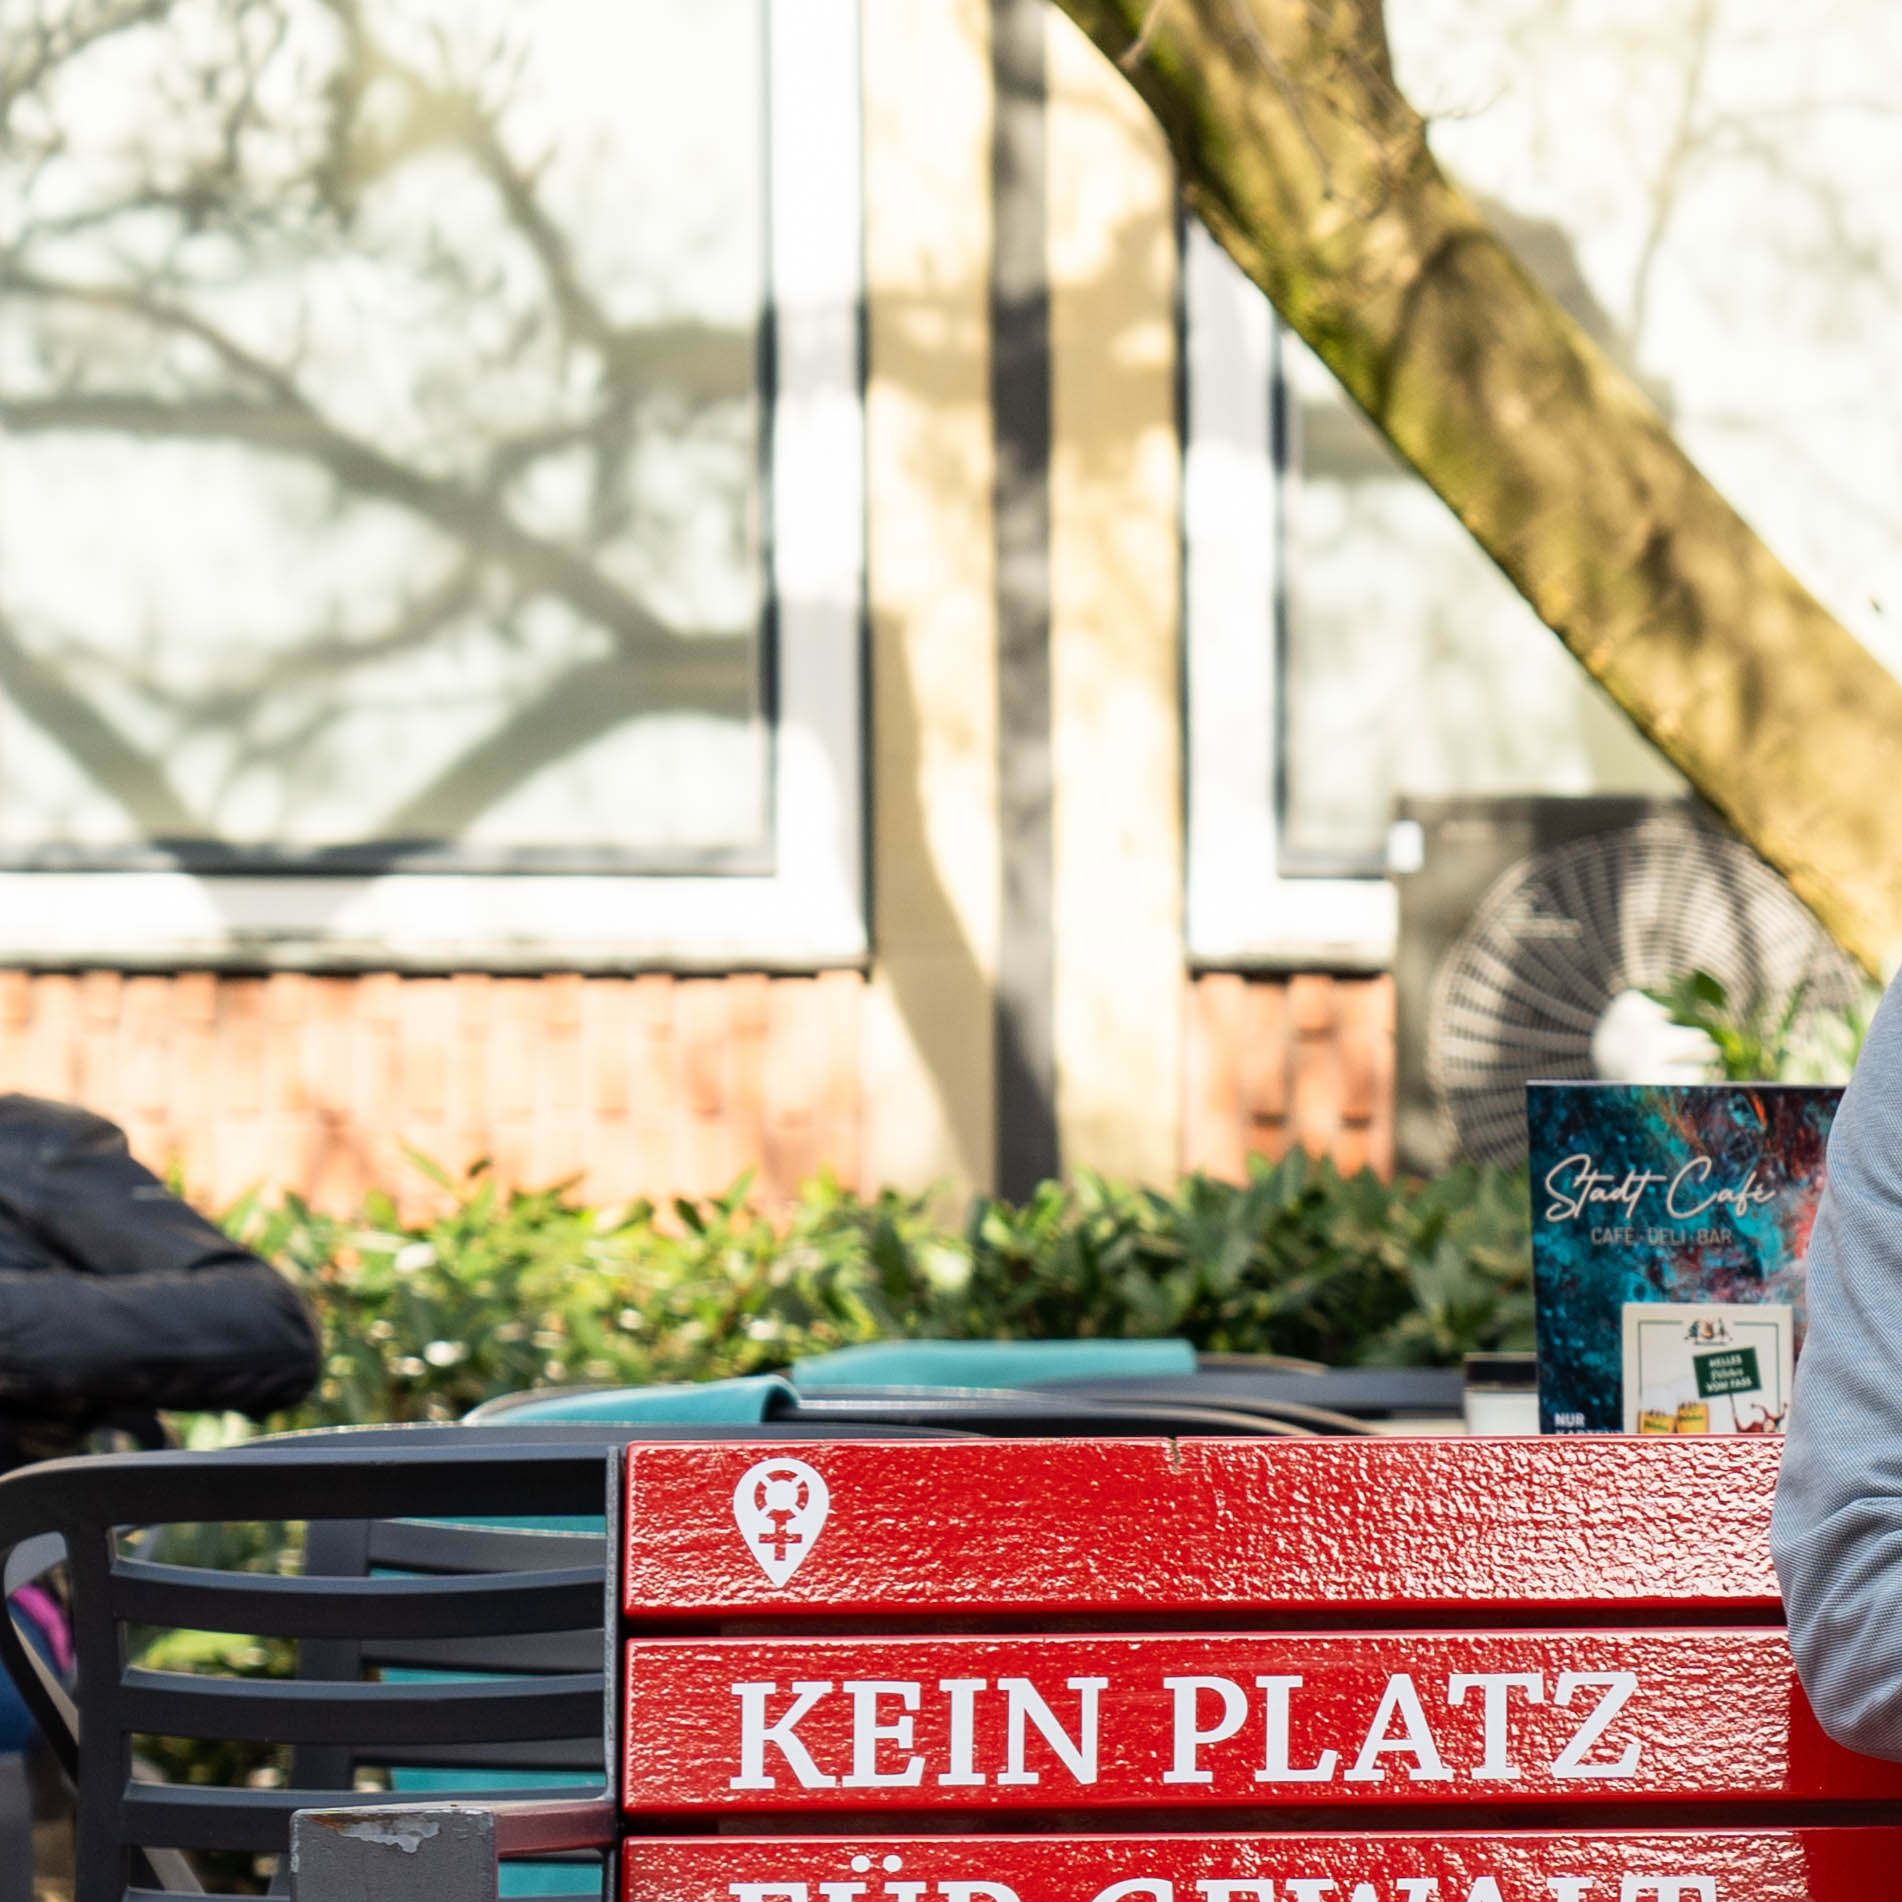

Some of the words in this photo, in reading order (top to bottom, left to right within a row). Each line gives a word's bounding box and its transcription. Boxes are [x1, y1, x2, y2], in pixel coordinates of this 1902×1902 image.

[1544, 1154, 1668, 1222] Stadt
[1648, 1228, 1686, 1245] DELI
[1697, 1229, 1733, 1245] BAR
[1554, 1412, 1585, 1427] NUR
[730, 1676, 1108, 1790] KEIN
[1163, 1672, 1646, 1784] PLATZ
